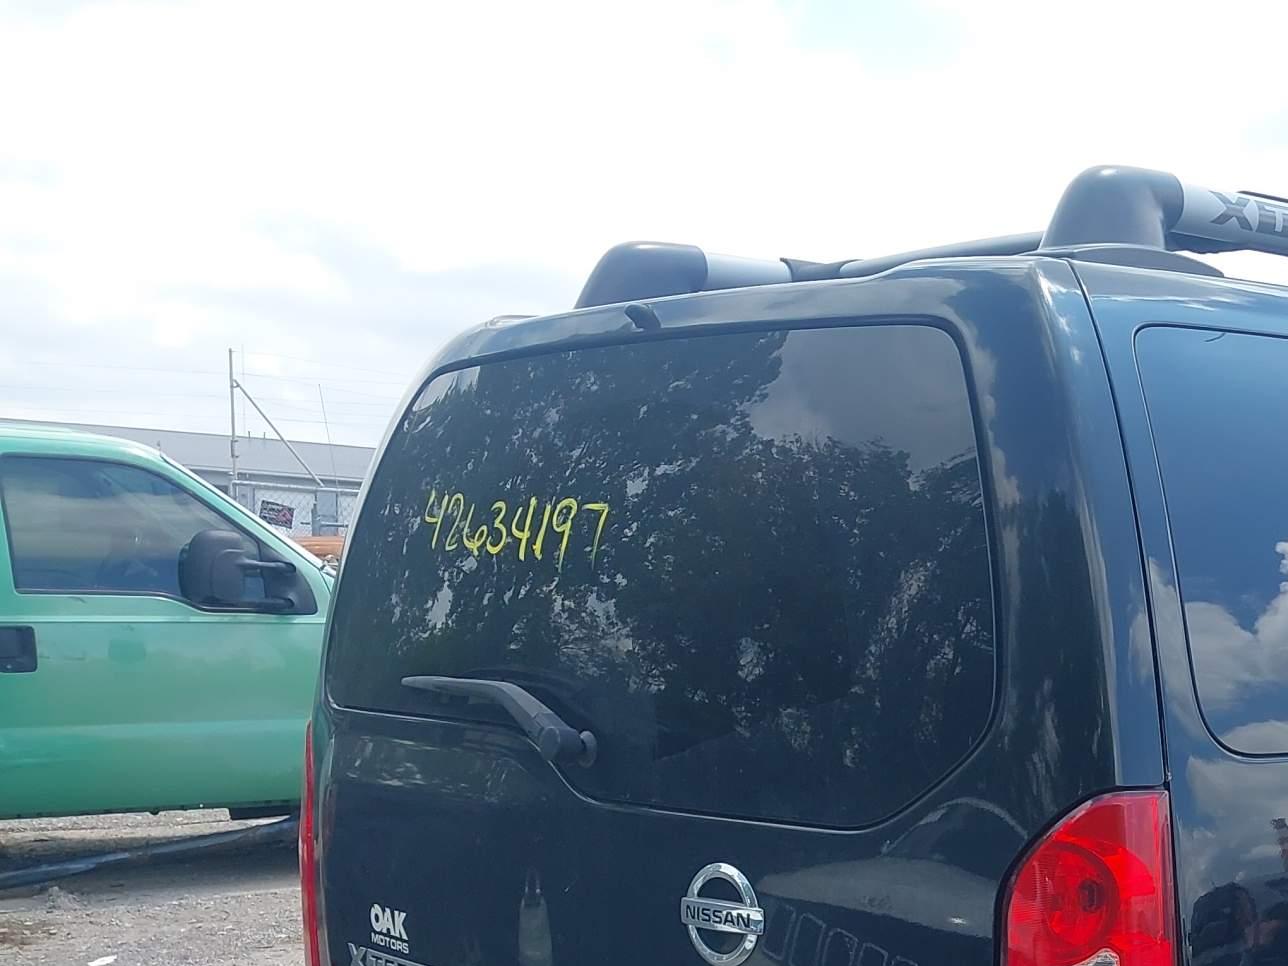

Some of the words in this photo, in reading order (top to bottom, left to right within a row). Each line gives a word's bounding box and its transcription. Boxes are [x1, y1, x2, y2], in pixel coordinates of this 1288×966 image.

[425, 488, 609, 572] 42634197
[370, 904, 408, 940] OAK
[686, 904, 750, 929] NISSAN
[371, 932, 409, 954] MOTORS
